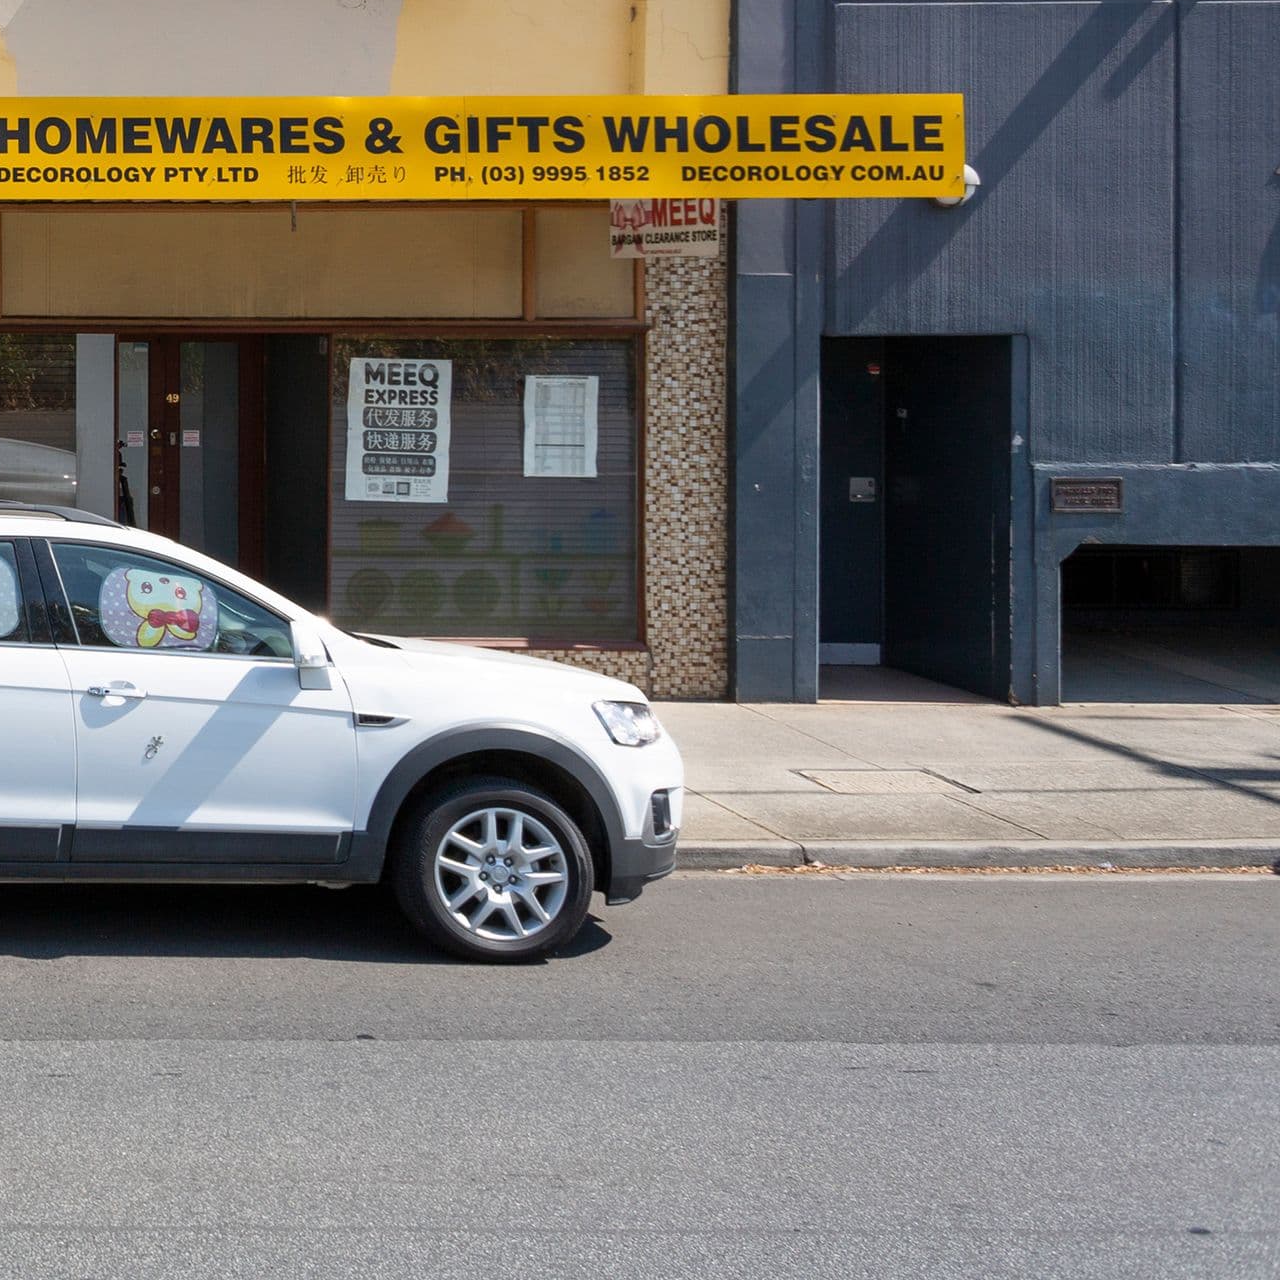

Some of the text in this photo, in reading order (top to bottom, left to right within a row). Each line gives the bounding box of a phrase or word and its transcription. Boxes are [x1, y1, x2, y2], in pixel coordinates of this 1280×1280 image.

[364, 117, 404, 155] &
[424, 115, 586, 154] GIFTS
[603, 115, 944, 154] WHOLESALE
[164, 167, 209, 183] PTY
[217, 167, 259, 183] LTD
[287, 164, 406, 185] 批发 卸売り
[481, 166, 525, 185] (03)
[532, 166, 587, 181] 9995
[595, 166, 650, 181] 1852
[651, 198, 716, 227] MEEQ
[645, 231, 690, 244] CLEARANCE
[692, 229, 718, 242] STORE
[364, 362, 439, 389] MEEQ
[166, 393, 180, 404] 49
[364, 389, 439, 406] EXPRESS
[366, 409, 434, 428] 代发服务
[366, 431, 434, 451] 快递服务
